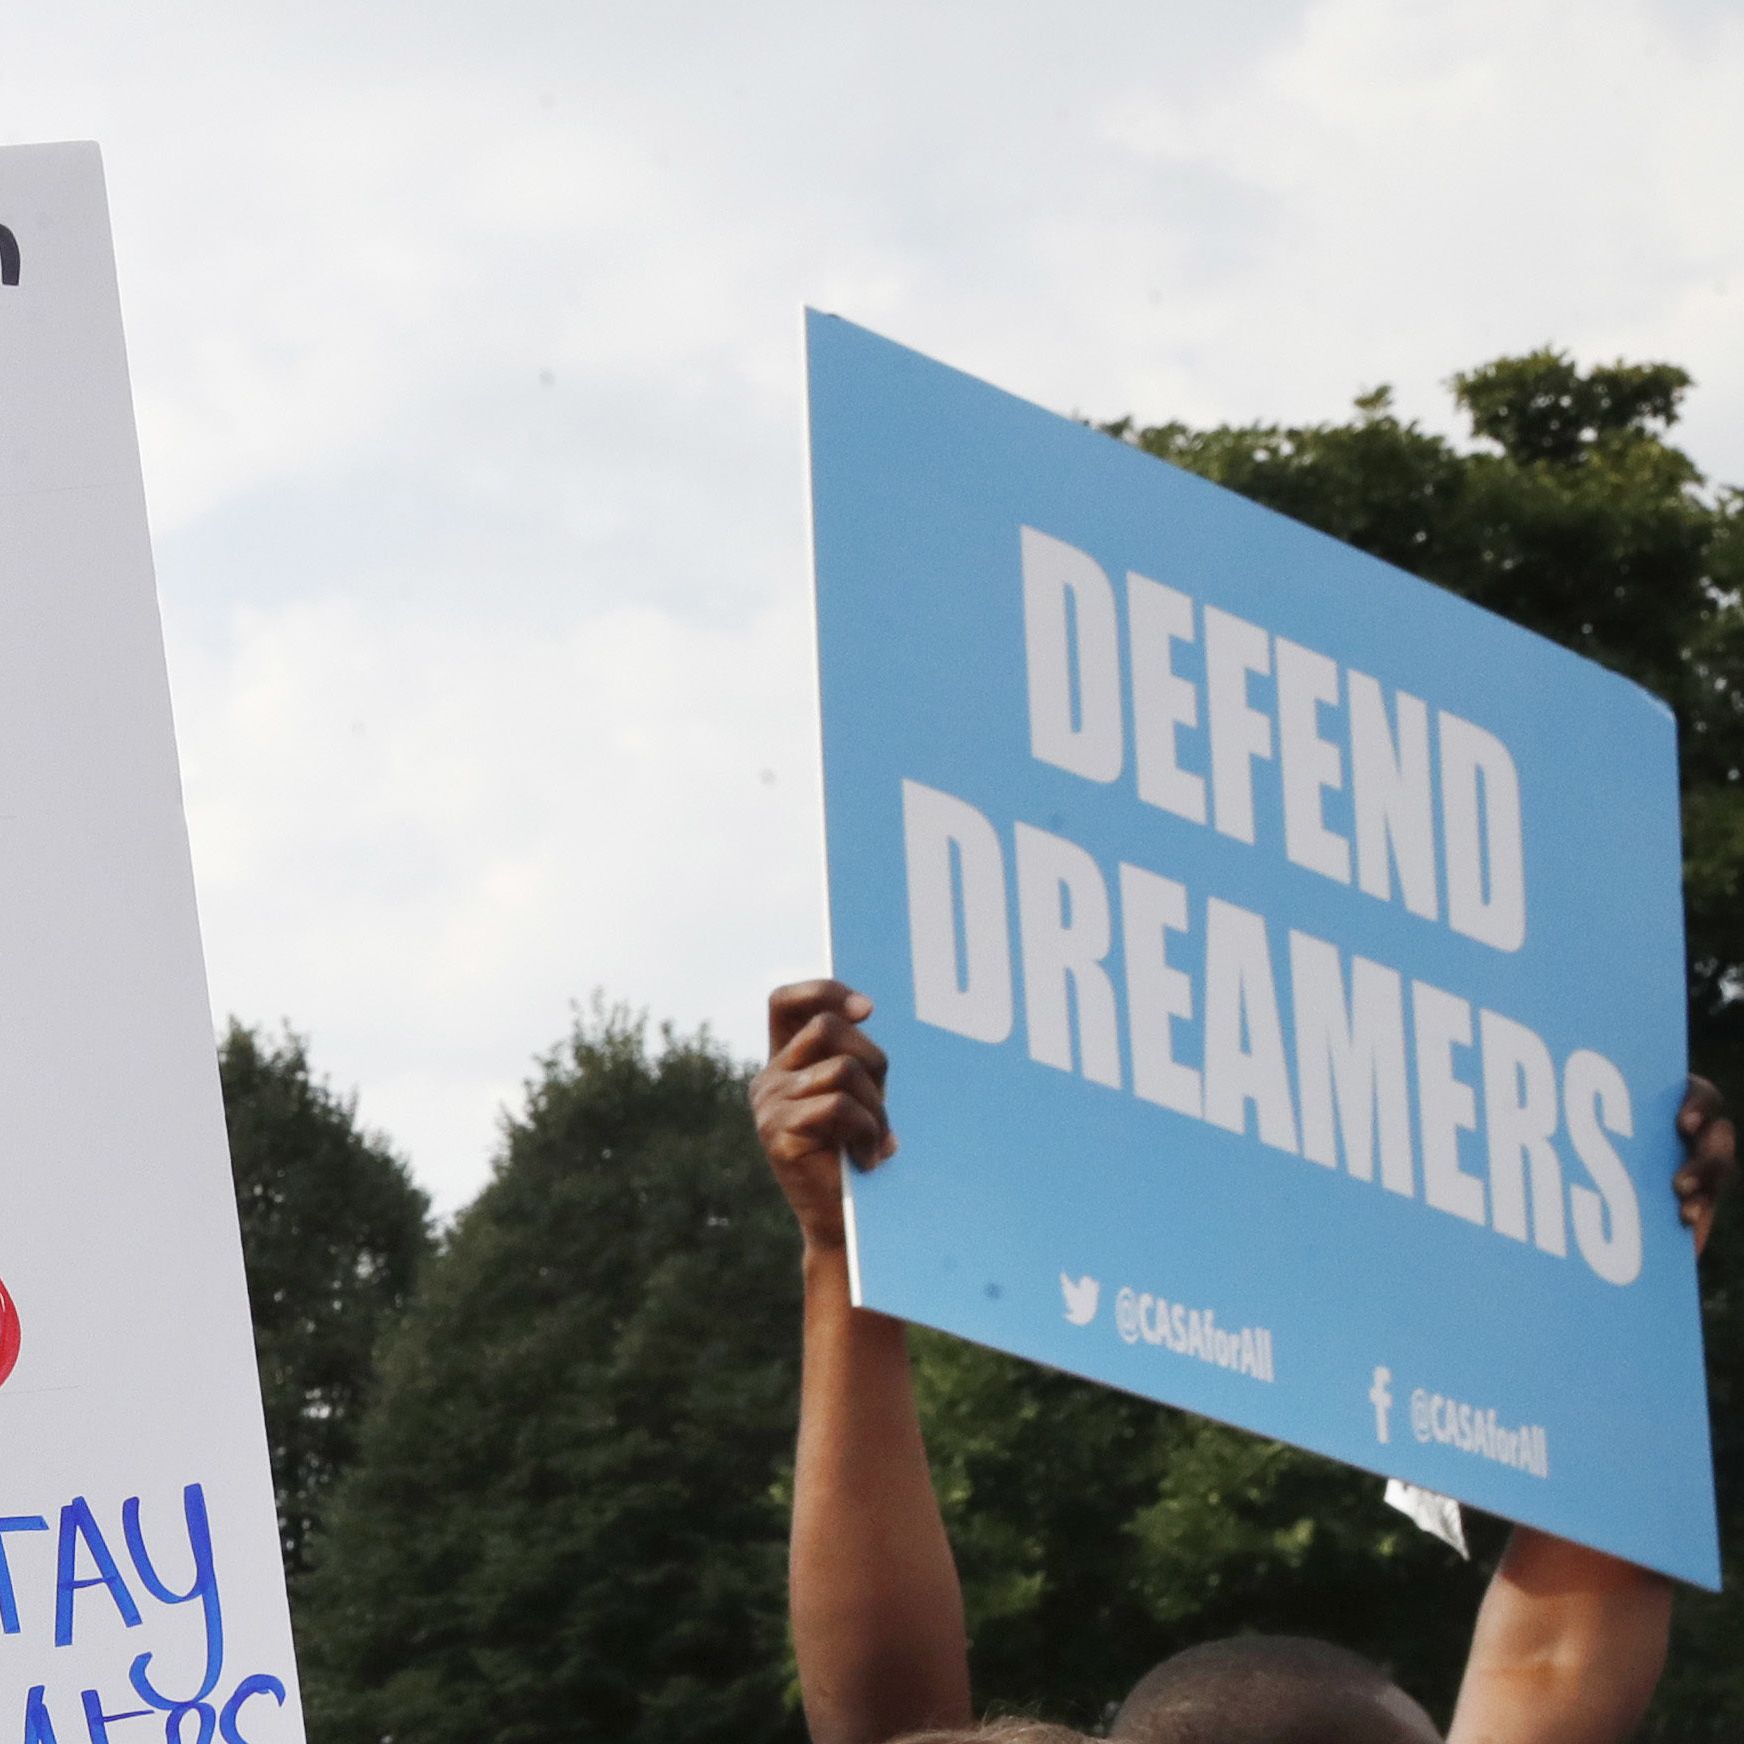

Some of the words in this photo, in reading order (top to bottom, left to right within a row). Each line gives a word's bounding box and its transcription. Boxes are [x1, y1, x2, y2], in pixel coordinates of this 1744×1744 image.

[1019, 524, 1527, 954] DEFEND
[901, 778, 1642, 1286] DREAMERS
[1114, 1284, 1275, 1384] @CASAforAll
[1411, 1387, 1549, 1479] @CASAforAll
